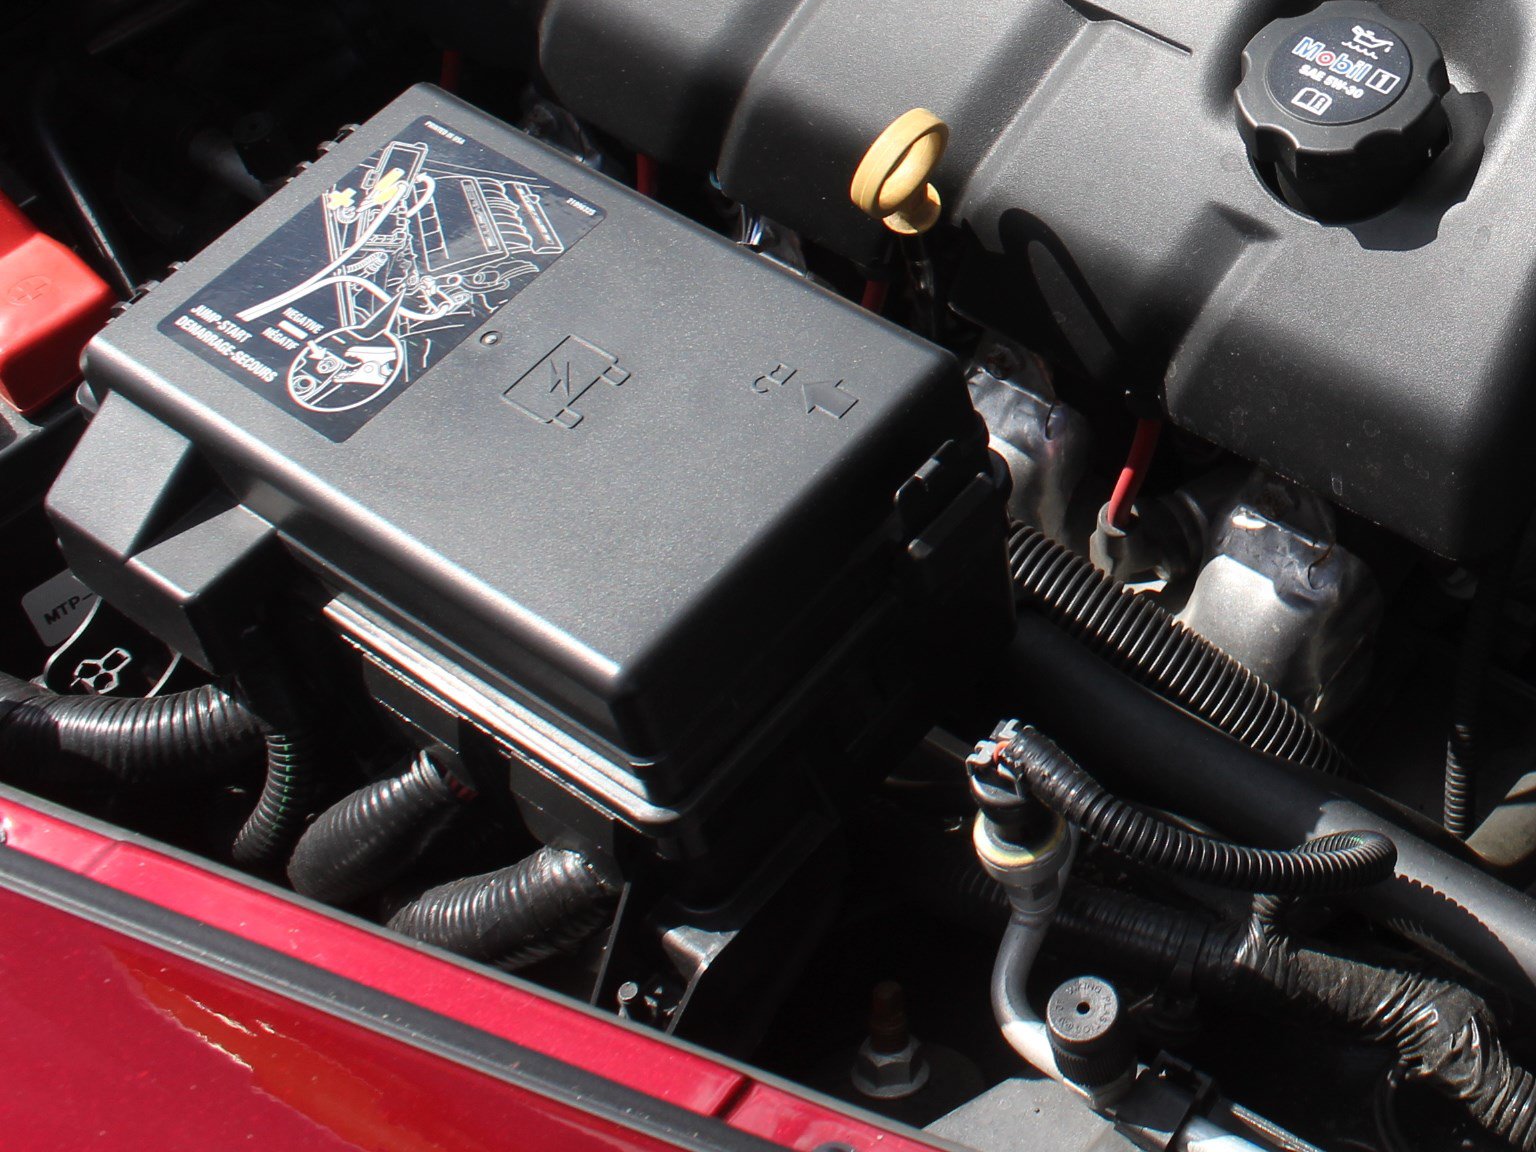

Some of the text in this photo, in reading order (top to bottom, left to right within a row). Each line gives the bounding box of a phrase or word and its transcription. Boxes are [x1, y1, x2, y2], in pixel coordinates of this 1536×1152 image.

[1293, 36, 1372, 83] Mobil
[1298, 64, 1324, 83] SAE
[190, 304, 253, 343] JUMP-START
[282, 307, 325, 335] NEGATIVE
[174, 315, 279, 383] DEMARRAGE-SECOURS
[261, 326, 300, 351] NÉGATIF
